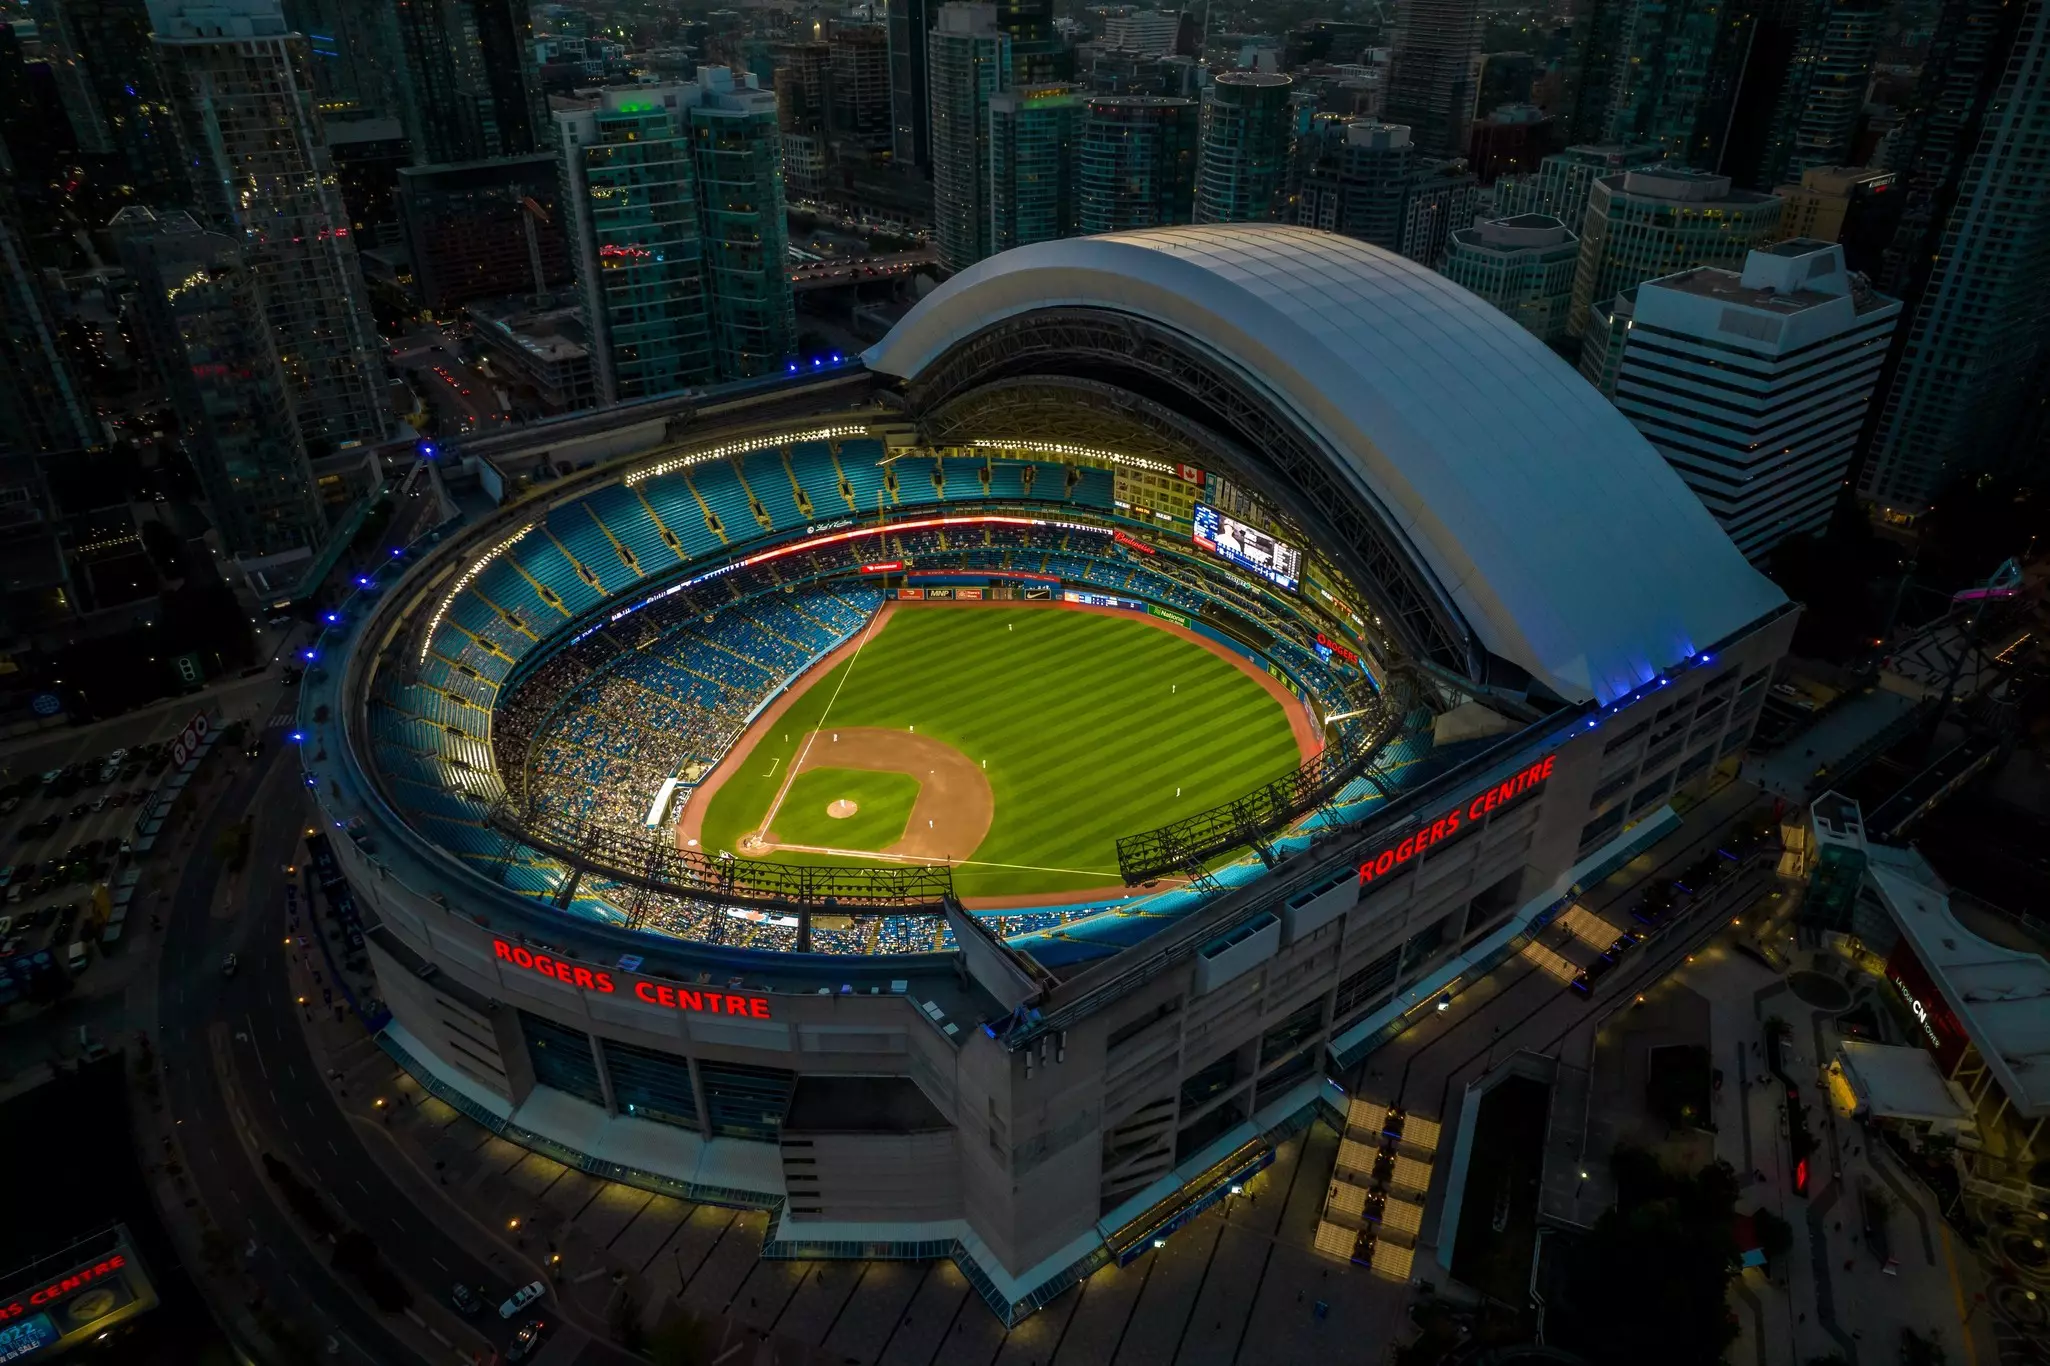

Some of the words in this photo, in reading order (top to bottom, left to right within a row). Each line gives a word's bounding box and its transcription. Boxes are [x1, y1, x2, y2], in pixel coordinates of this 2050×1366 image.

[1115, 531, 1156, 554] Budweiser
[1161, 610, 1185, 624] National
[1326, 640, 1358, 664] ROGERS
[1358, 809, 1462, 884] ROGERS
[1468, 754, 1556, 820] CENTRE
[493, 940, 614, 993] ROGERS
[635, 982, 771, 1021] CENTRE
[1902, 985, 1913, 1004] TOUR
[1912, 1000, 1926, 1023] CN
[1923, 1023, 1940, 1048] TOWER
[30, 1256, 125, 1304] CENTRE
[9, 1328, 46, 1349] TICKETS
